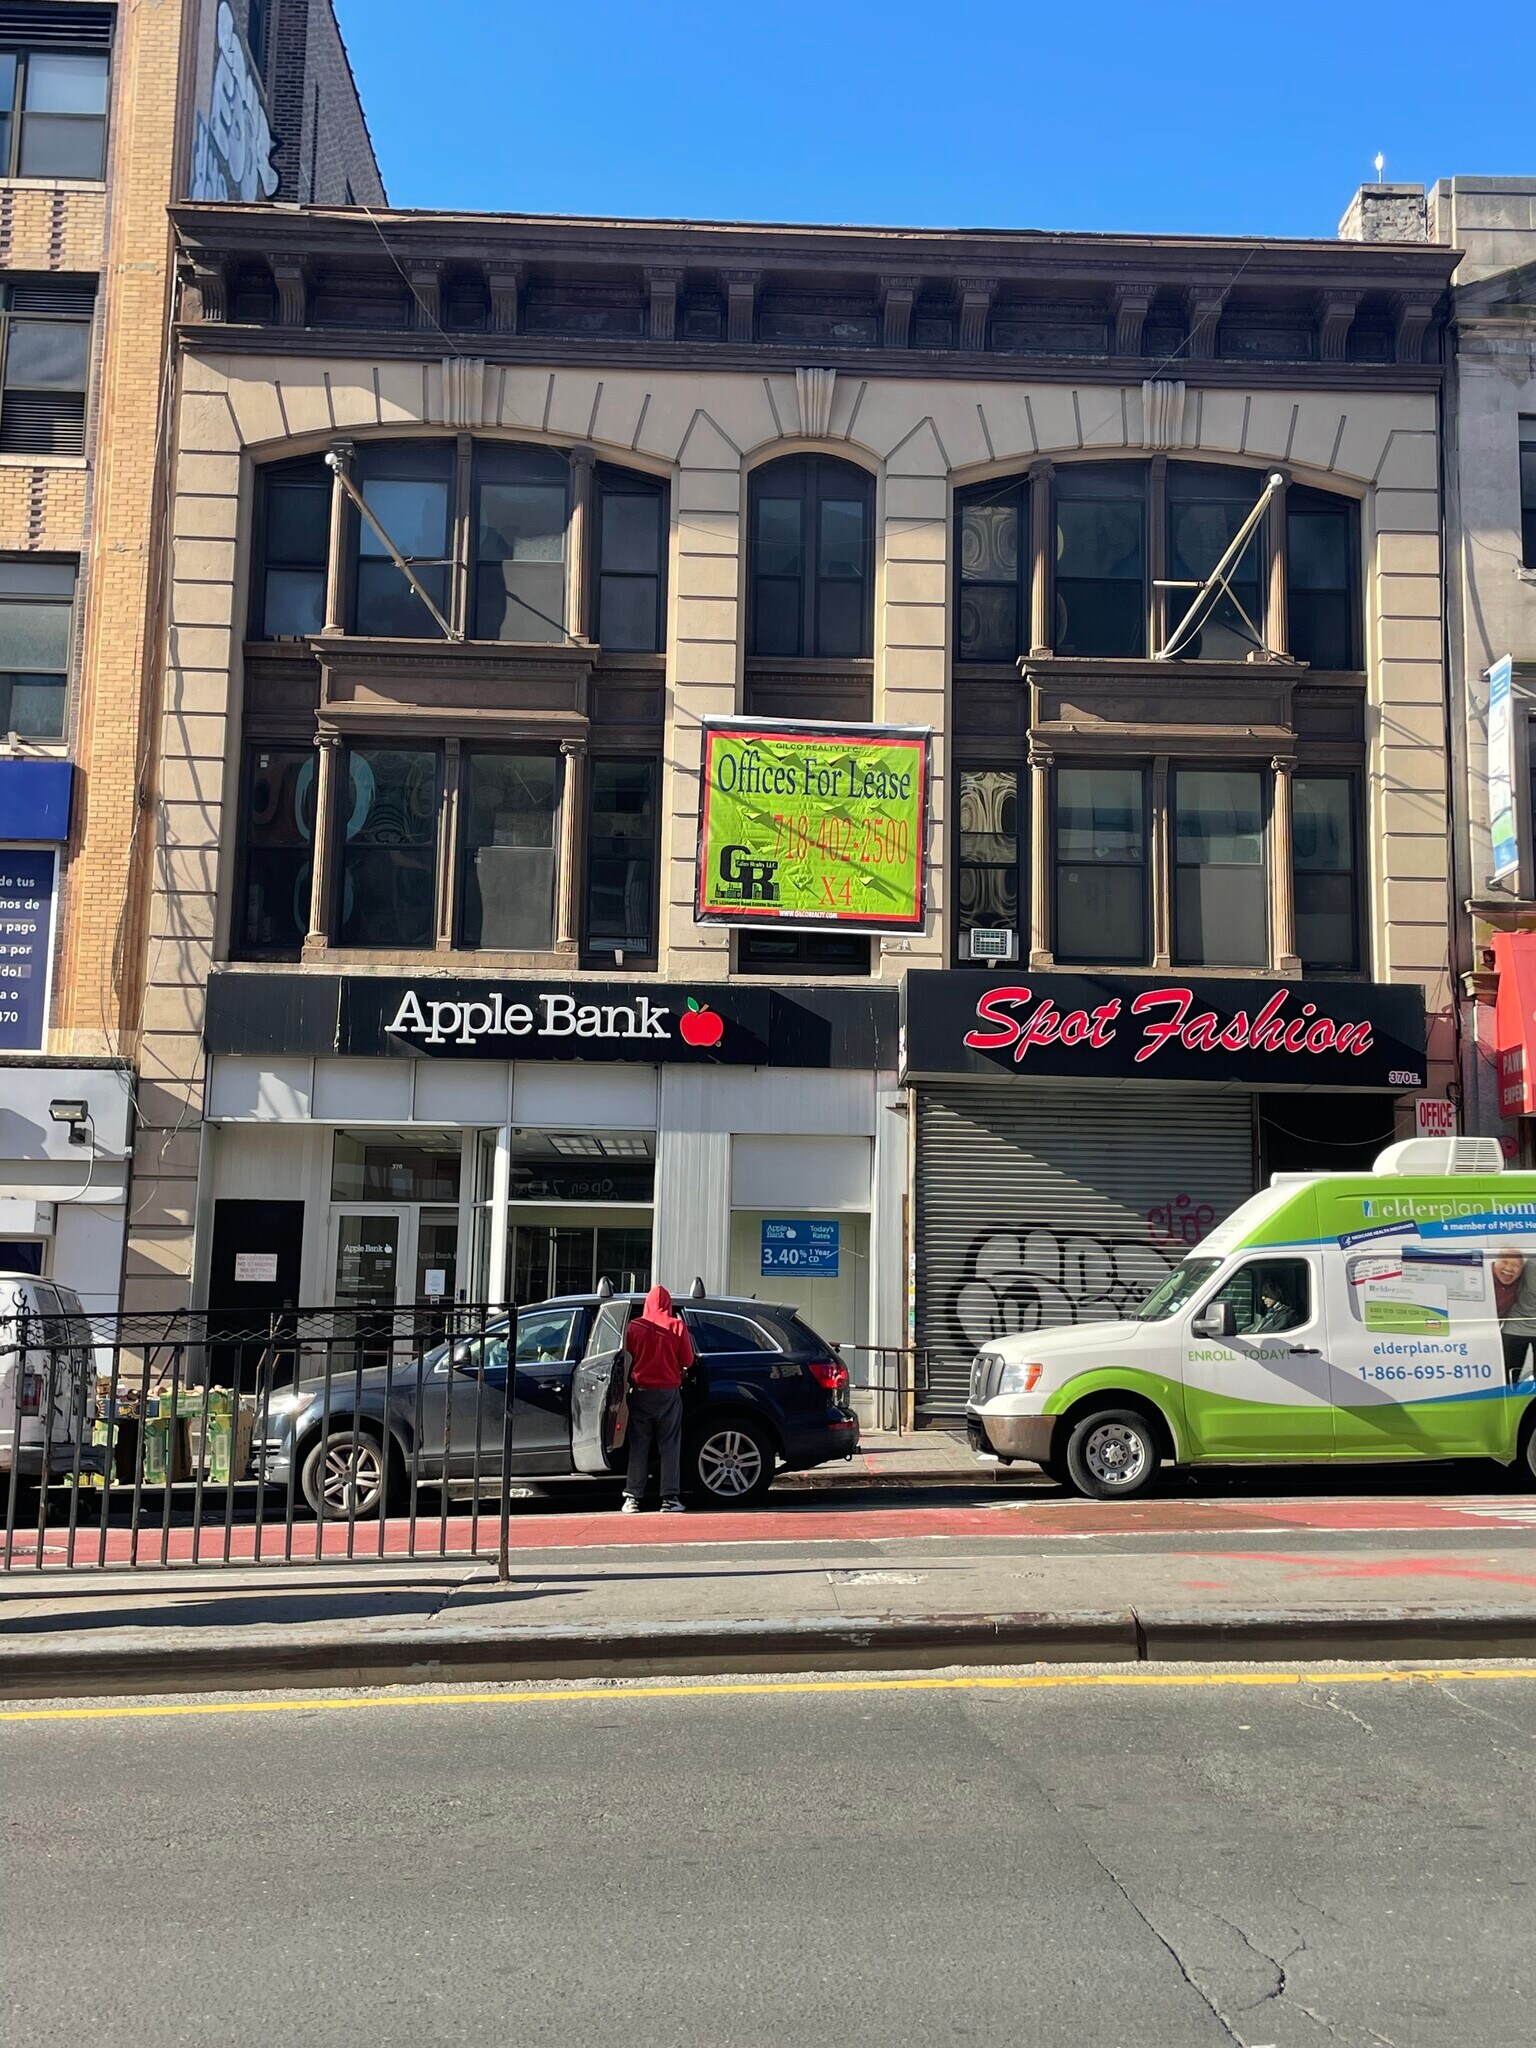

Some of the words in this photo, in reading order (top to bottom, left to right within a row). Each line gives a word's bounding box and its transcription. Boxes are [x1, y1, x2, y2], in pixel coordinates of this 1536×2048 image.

[776, 743, 803, 751] GILCO
[805, 744, 840, 752] REALTY
[717, 749, 796, 796] Offices
[803, 758, 842, 798] For
[848, 760, 911, 801] Lease
[773, 814, 909, 865] 718-402-2500
[17, 877, 35, 887] tus
[818, 876, 853, 906] X4
[25, 899, 40, 910] de
[6, 922, 37, 935] pago
[10, 945, 32, 958] por
[0, 966, 21, 977] do!
[11, 991, 18, 1000] o
[384, 990, 534, 1044] Apple
[538, 993, 671, 1039] Bank
[963, 986, 1121, 1063] Spot
[1131, 987, 1374, 1063] Fashion
[1420, 1102, 1452, 1127] OFFICE
[1382, 1199, 1484, 1222] elderplan
[1490, 1197, 1536, 1215] hom
[767, 1224, 788, 1232] Apple
[809, 1225, 834, 1234] Today's
[1450, 1222, 1488, 1231] member
[1490, 1221, 1498, 1230] of
[812, 1232, 831, 1240] Rates
[344, 1244, 364, 1253] Apple
[365, 1244, 384, 1253] Bank
[1188, 1350, 1236, 1361] ENROLL
[1240, 1349, 1290, 1361] TODAY!
[1373, 1341, 1468, 1357] elderplan.org
[1358, 1364, 1492, 1380] 1-866-695-8110
